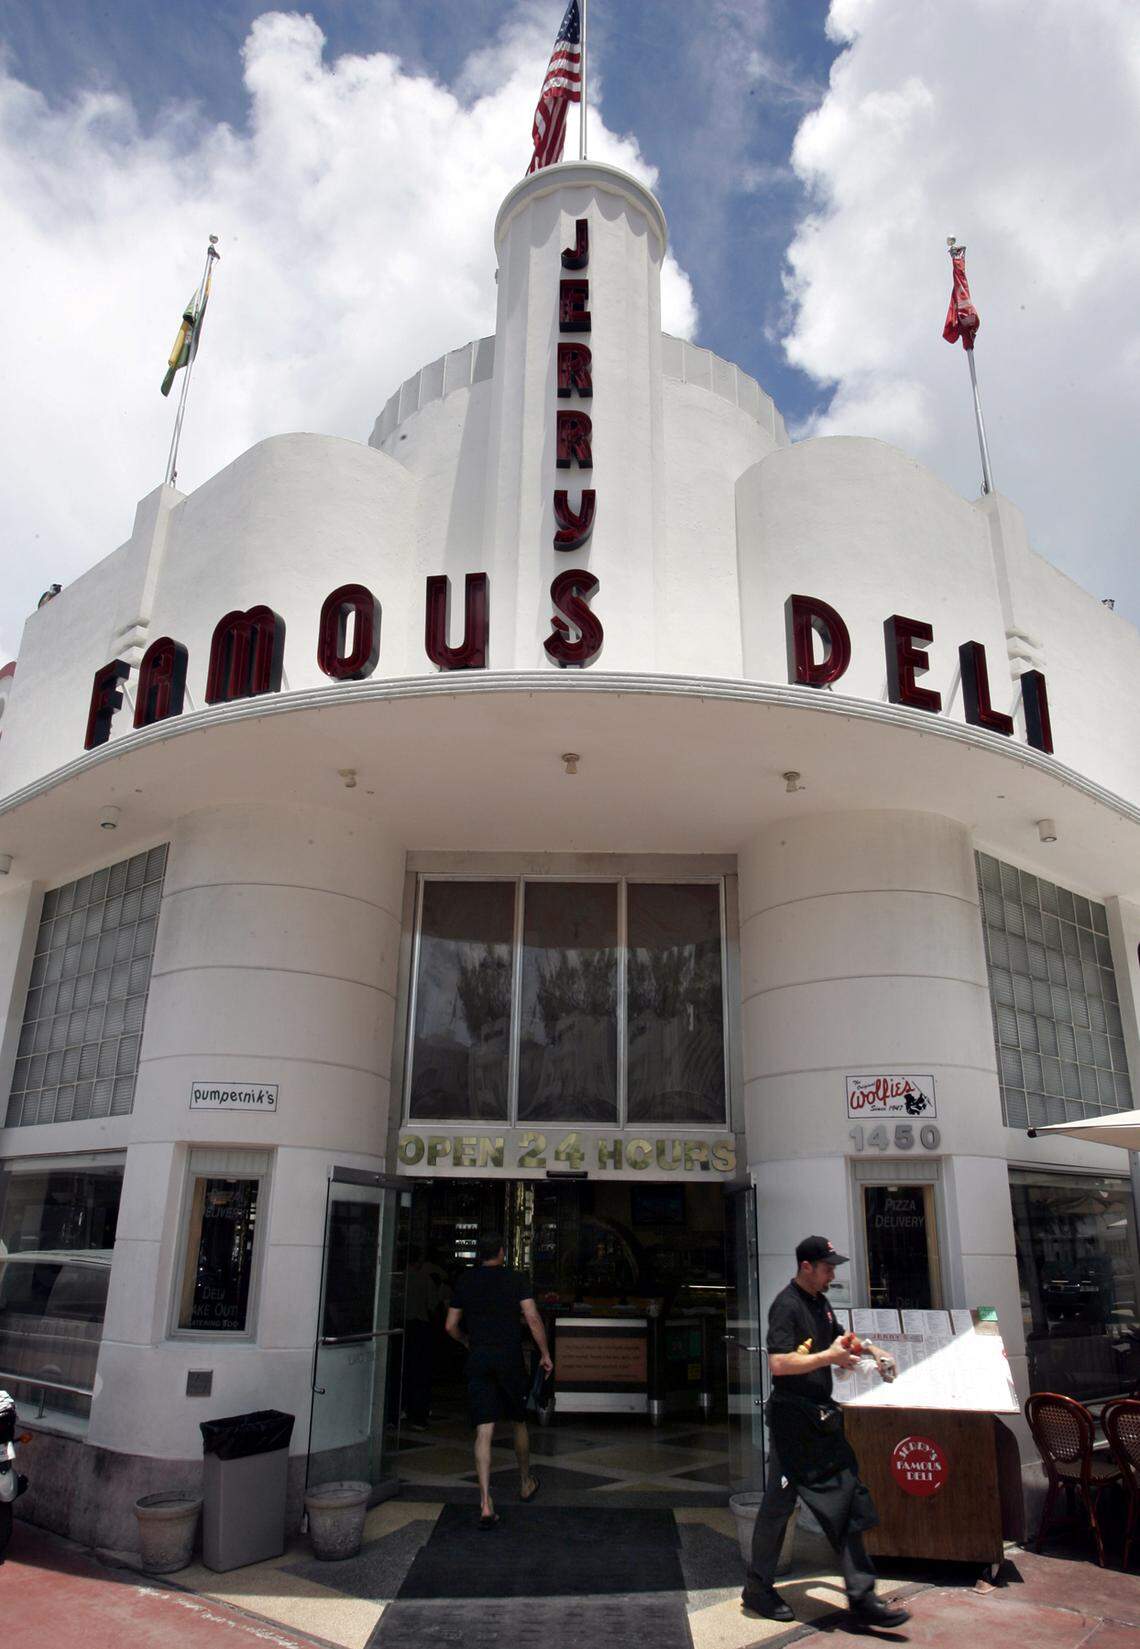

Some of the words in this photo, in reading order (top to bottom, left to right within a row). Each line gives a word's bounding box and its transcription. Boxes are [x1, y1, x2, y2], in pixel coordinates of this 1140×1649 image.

[84, 569, 604, 751] FAMOUS
[784, 594, 1054, 755] DELI
[194, 1088, 275, 1105] pumpernik's
[849, 1124, 941, 1152] 1450
[399, 1134, 505, 1168] OPEN
[517, 1131, 585, 1170] 24
[598, 1137, 737, 1173] HOURS
[875, 1214, 925, 1228] DELIVERY
[896, 1461, 942, 1471] FAMOUS
[906, 1471, 933, 1481] DELI
